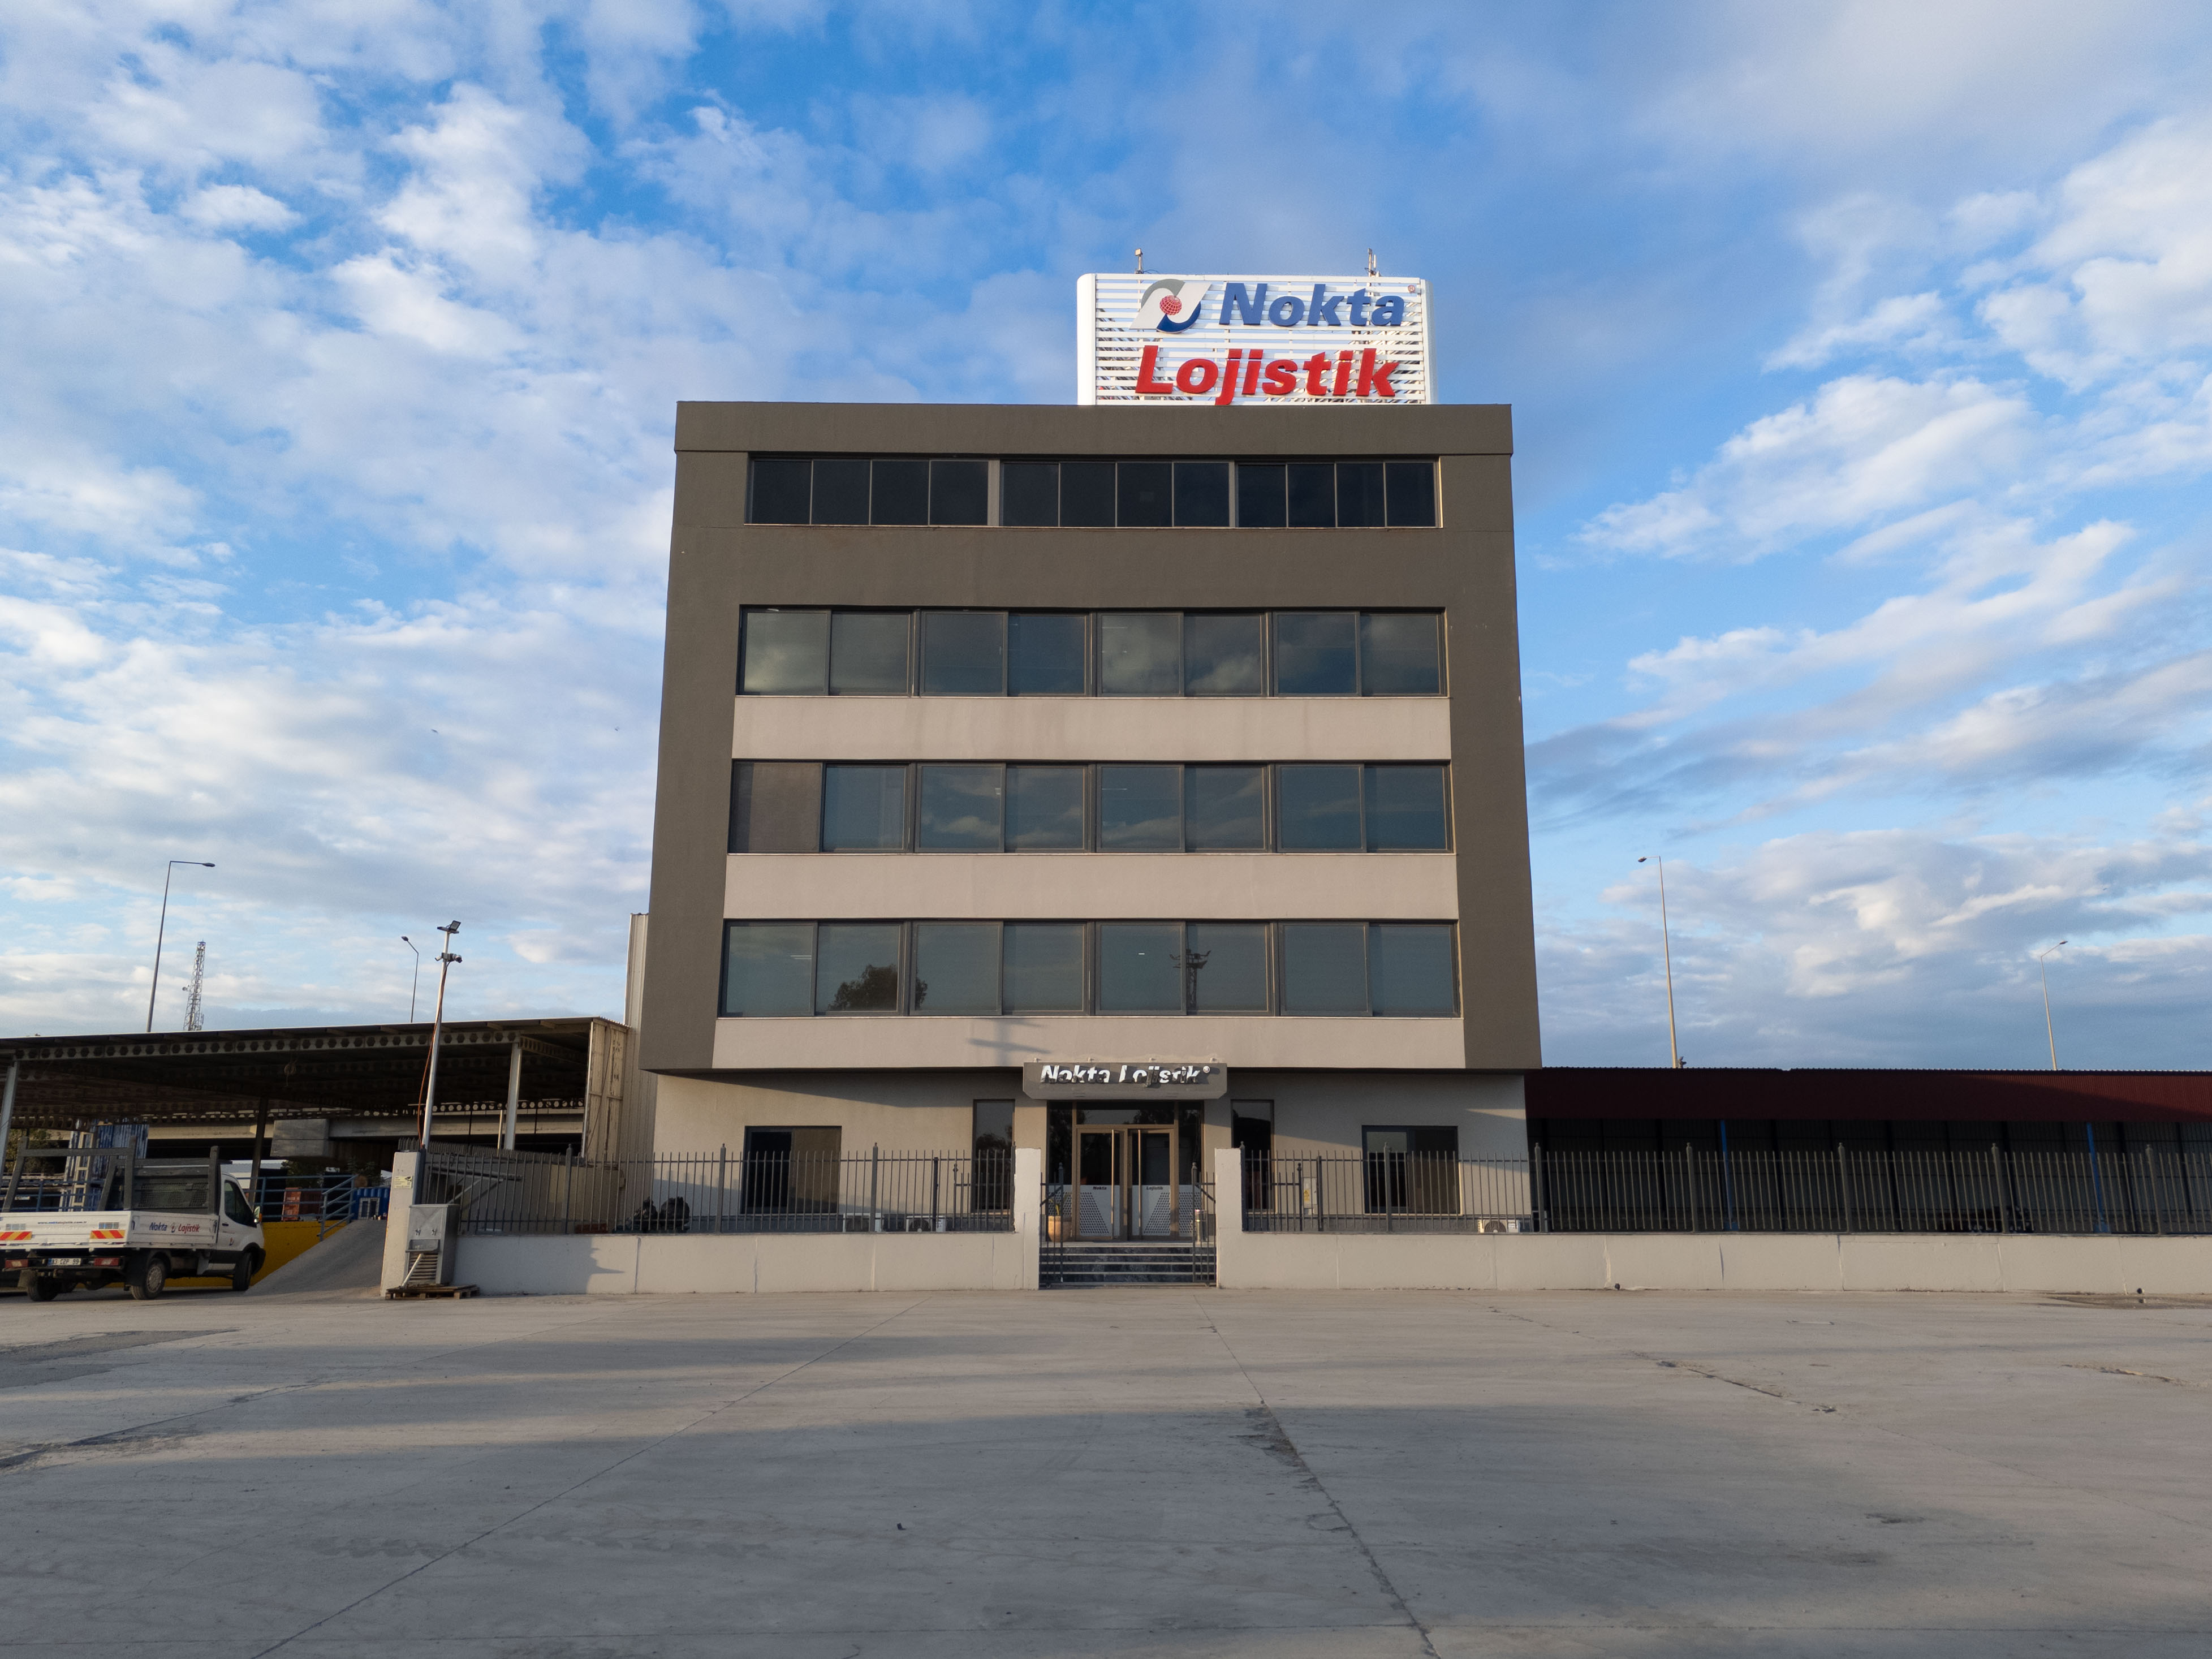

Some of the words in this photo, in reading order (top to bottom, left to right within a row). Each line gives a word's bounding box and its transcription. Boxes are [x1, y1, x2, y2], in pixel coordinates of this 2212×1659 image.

[1219, 283, 1404, 327] Nokta
[1135, 345, 1399, 406] Lojistik
[1040, 1065, 1110, 1084] Nokta
[149, 1222, 167, 1231] Nokta
[178, 1224, 200, 1234] Lojistik
